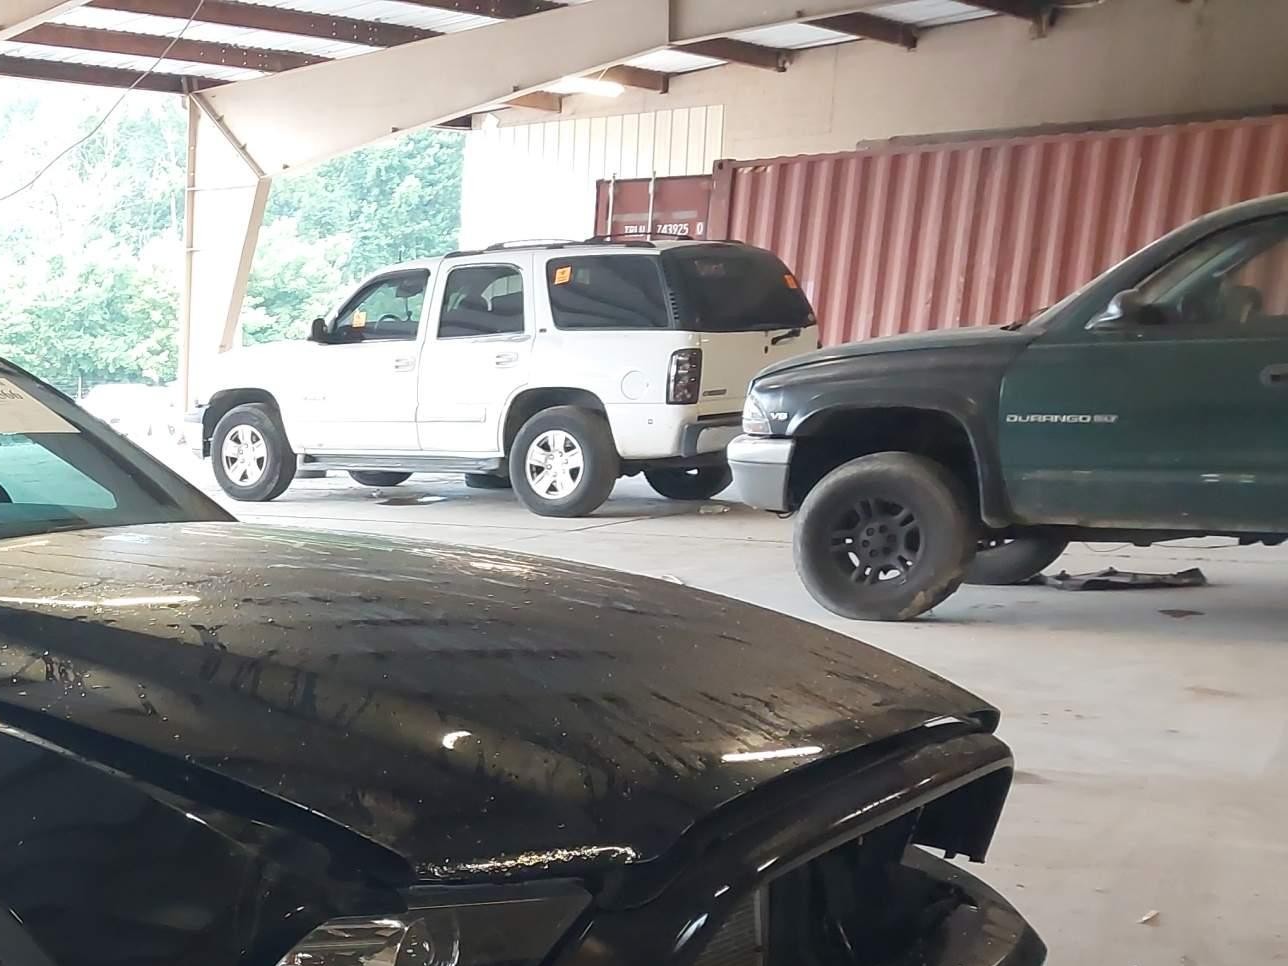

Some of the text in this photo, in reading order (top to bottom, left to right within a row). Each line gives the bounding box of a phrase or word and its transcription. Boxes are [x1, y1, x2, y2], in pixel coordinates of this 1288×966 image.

[656, 223, 689, 236] 743925
[696, 221, 704, 235] 0
[770, 412, 789, 420] V8
[1006, 414, 1092, 422] DURANGO
